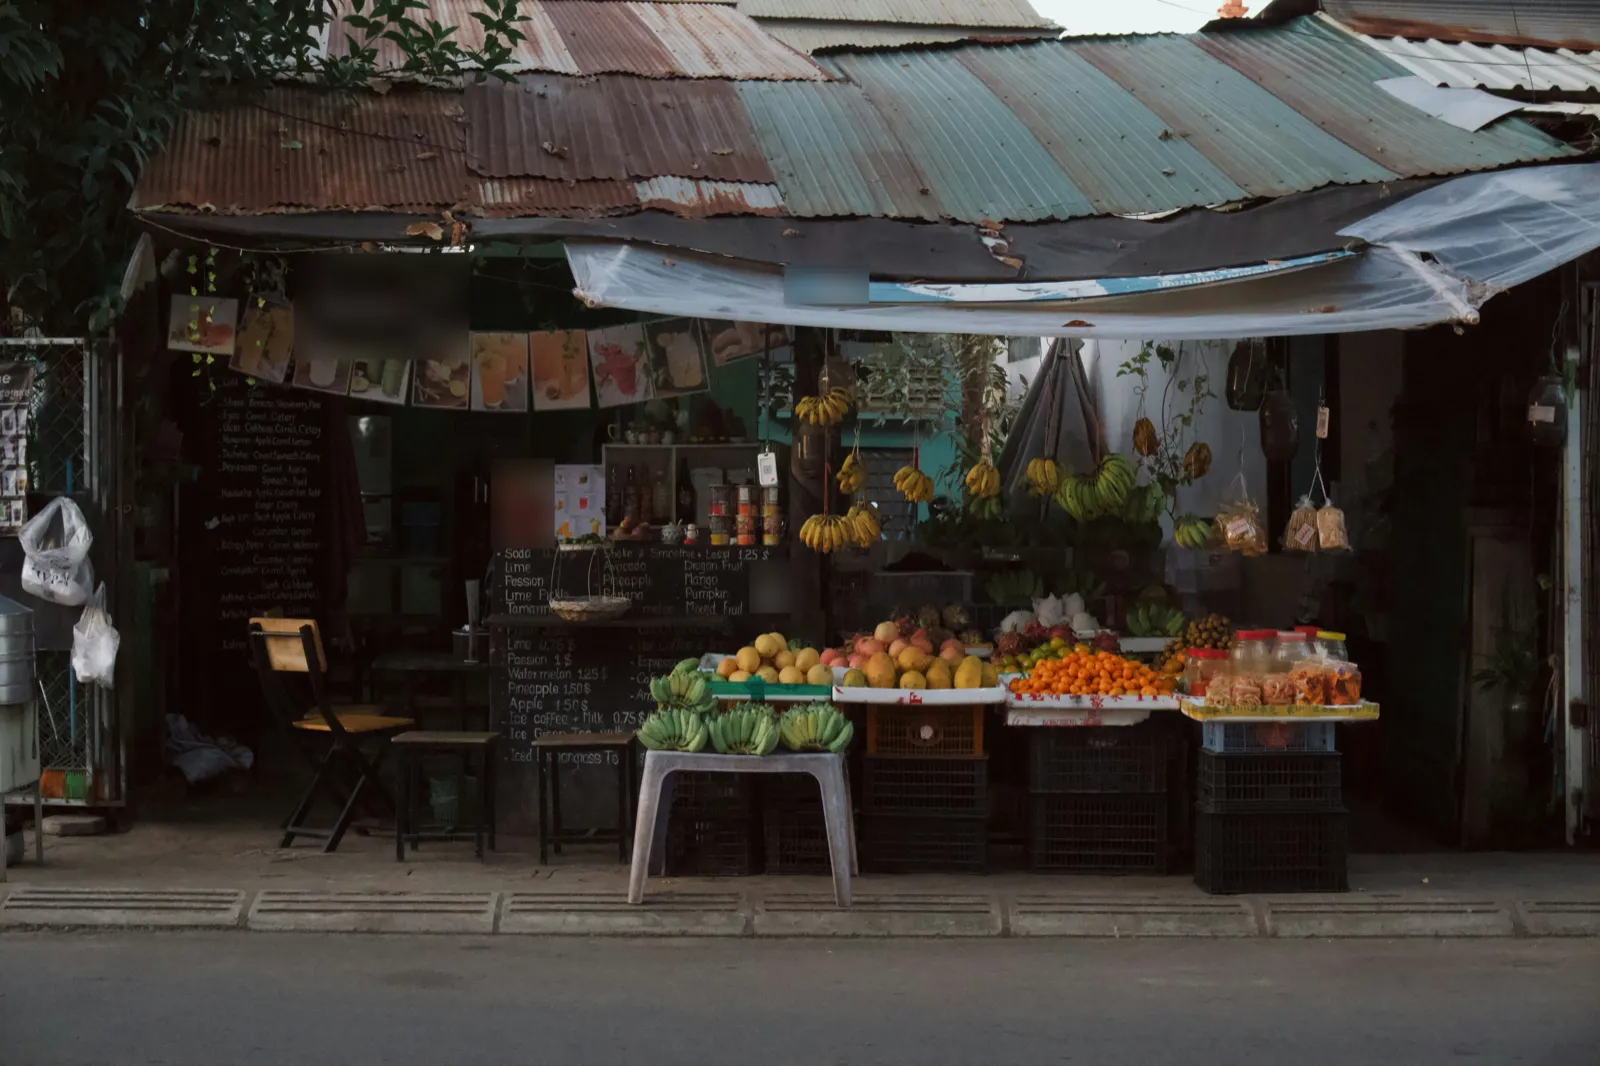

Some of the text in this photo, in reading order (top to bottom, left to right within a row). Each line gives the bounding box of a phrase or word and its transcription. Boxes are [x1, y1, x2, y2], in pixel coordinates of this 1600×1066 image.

[505, 548, 531, 559] Soda
[706, 548, 730, 560] Lassi
[505, 562, 531, 573] Lime
[684, 561, 743, 574] Dragon Fruit
[505, 575, 544, 587] Passion
[684, 573, 718, 588] Mango
[505, 589, 532, 602] Lime
[685, 588, 730, 604] Pumpkin
[506, 602, 555, 615] Tamarin
[685, 601, 716, 615] Mixed
[507, 638, 531, 650] Lime
[507, 652, 547, 665] Passion
[508, 682, 559, 698] Pineapple
[509, 697, 543, 713] Apple
[509, 712, 527, 725] Ice
[583, 711, 604, 724] Milk
[509, 727, 527, 740] Ice
[511, 748, 533, 763] Iced
